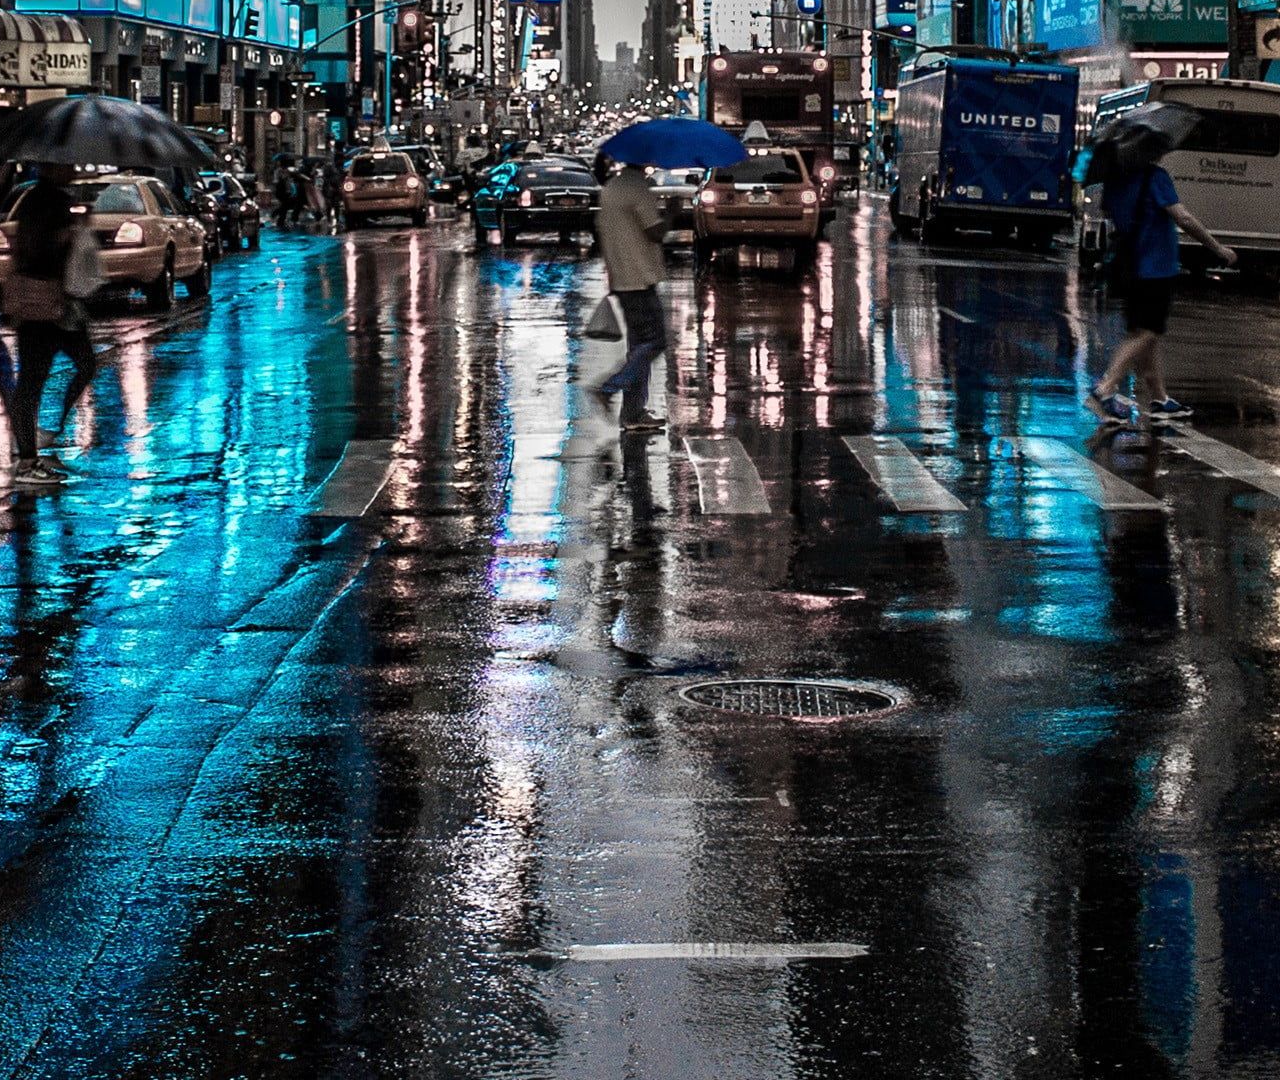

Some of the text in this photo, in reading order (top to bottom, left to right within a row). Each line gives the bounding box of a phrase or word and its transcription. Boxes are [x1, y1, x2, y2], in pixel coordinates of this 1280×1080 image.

[1122, 12, 1183, 21] NEW YORK
[45, 52, 88, 70] RIDAY'S
[960, 112, 1037, 129] UNITED
